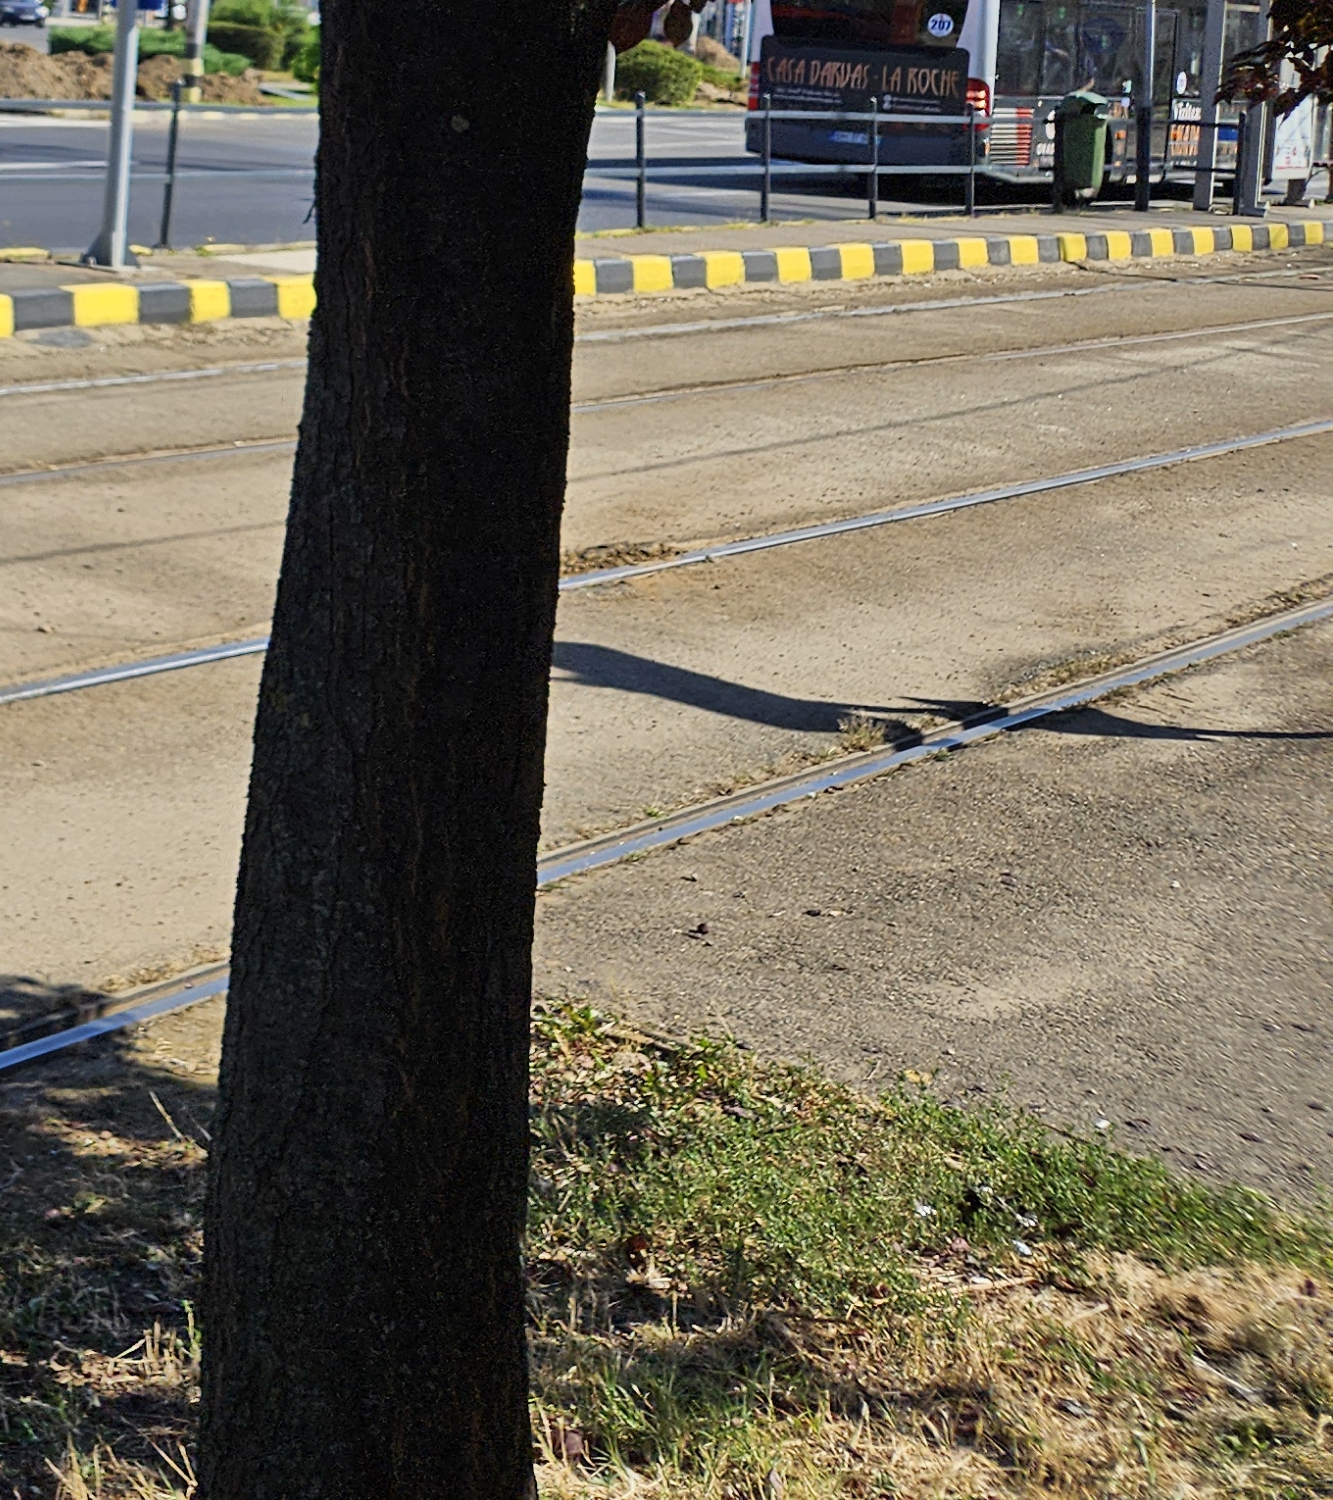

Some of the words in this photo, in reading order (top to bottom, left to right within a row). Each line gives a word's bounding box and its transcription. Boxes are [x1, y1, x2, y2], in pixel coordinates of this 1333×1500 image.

[931, 19, 951, 31] 207
[767, 56, 806, 83] CASA
[883, 65, 902, 93] LA
[906, 67, 960, 98] ROCHE
